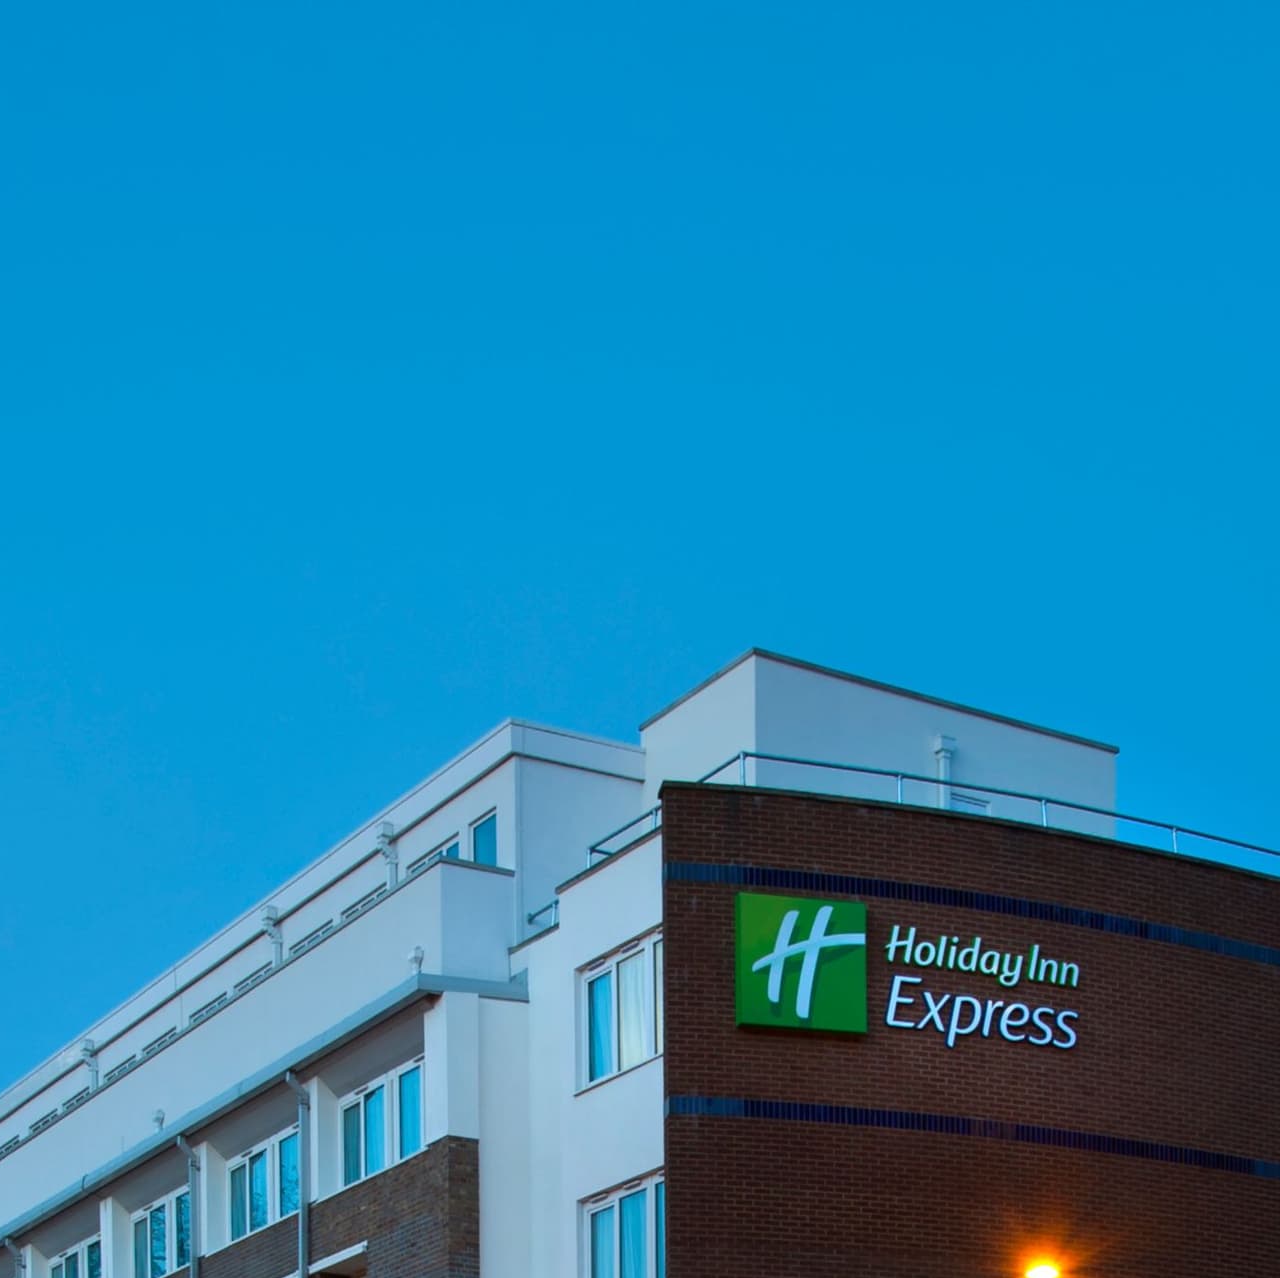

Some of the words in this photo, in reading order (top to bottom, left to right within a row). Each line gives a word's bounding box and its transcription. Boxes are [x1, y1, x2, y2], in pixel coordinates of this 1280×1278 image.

[885, 924, 1024, 987] Holiday
[1027, 944, 1080, 988] Inn
[885, 974, 1080, 1048] Express
